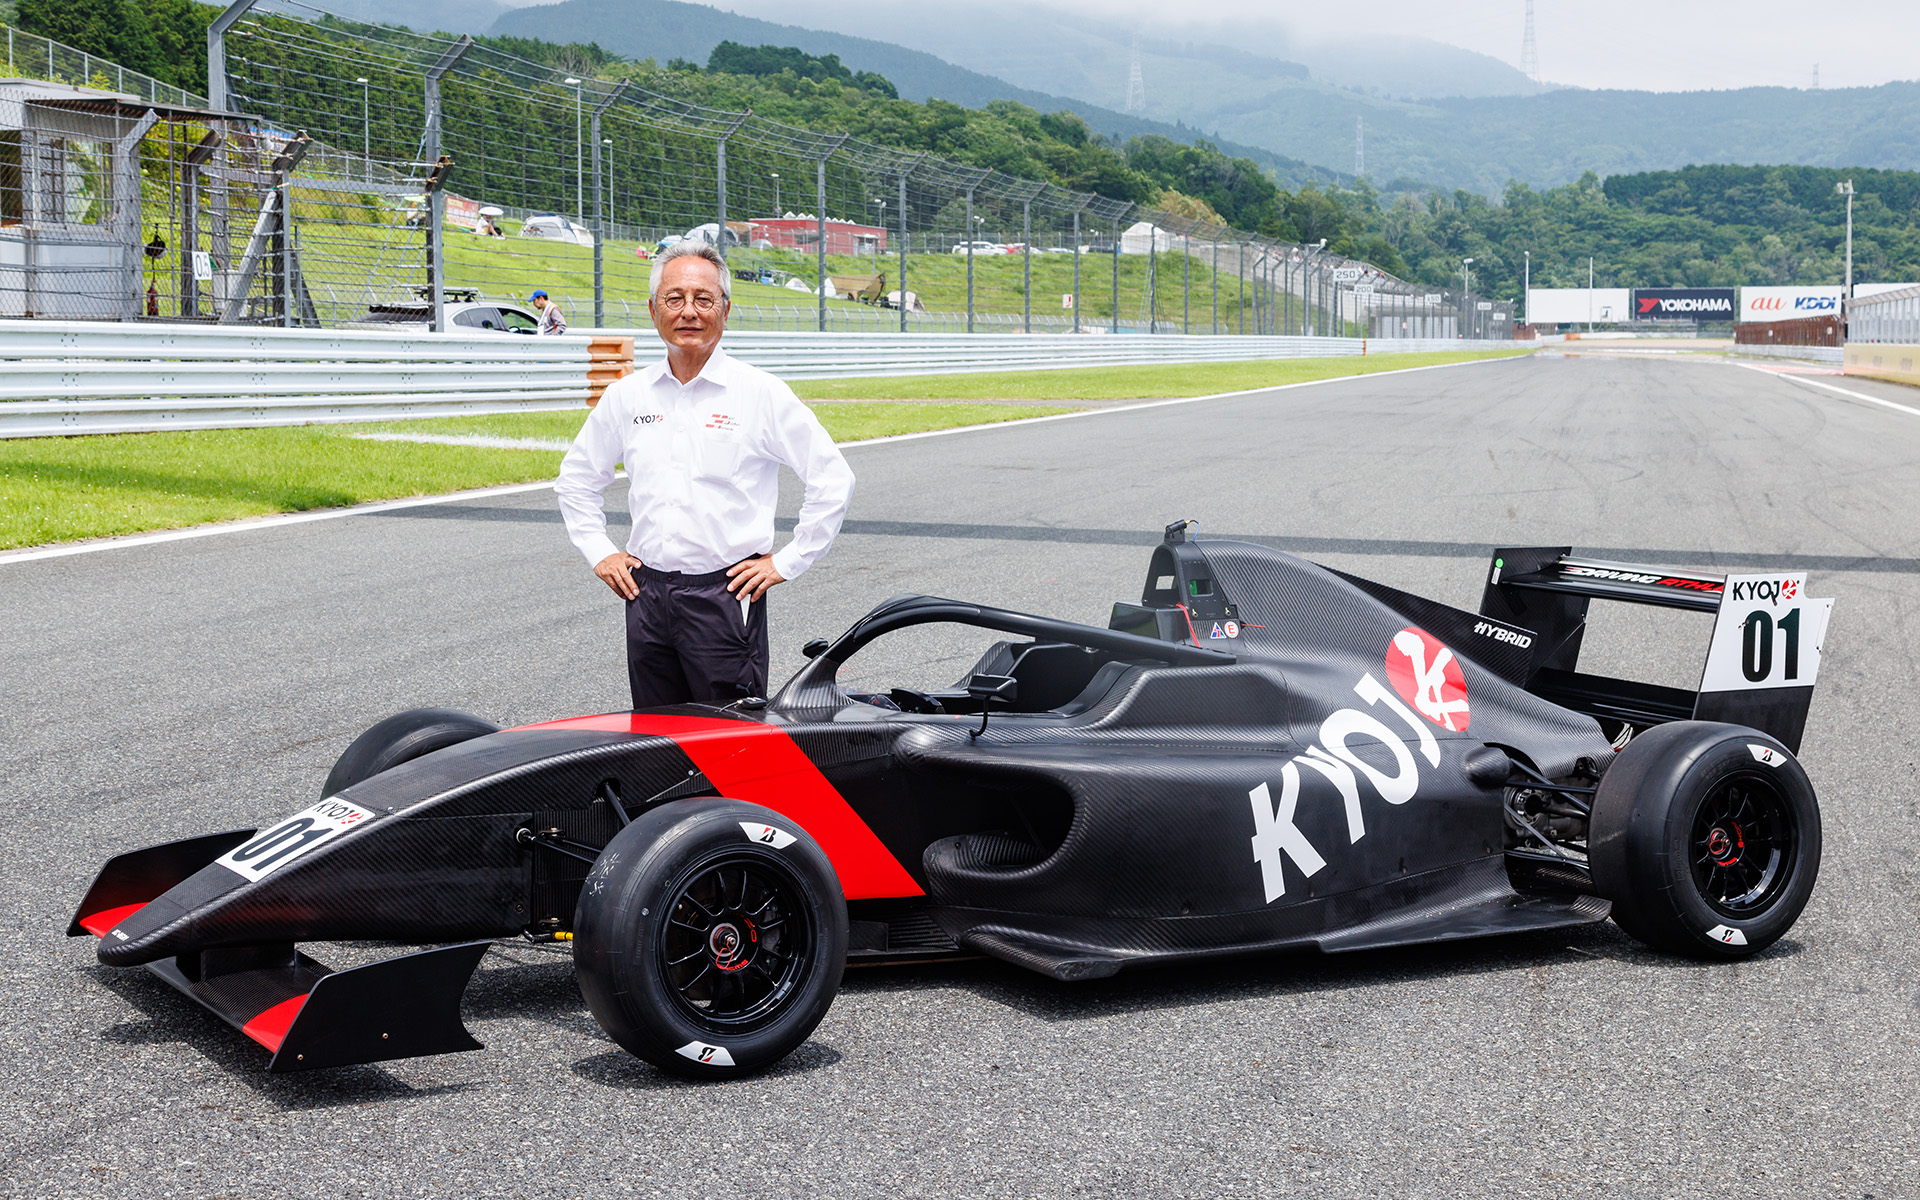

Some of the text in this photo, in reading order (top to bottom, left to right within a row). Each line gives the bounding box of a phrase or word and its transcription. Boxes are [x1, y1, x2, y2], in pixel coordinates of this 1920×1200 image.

[1336, 270, 1356, 279] 250
[1659, 298, 1732, 312] YOKOHAMA
[1750, 297, 1836, 311] au KDDI
[1566, 566, 1663, 584] DRIVING
[1473, 621, 1532, 649] HYBRID
[1741, 607, 1801, 683] 01
[231, 817, 334, 872] 01
